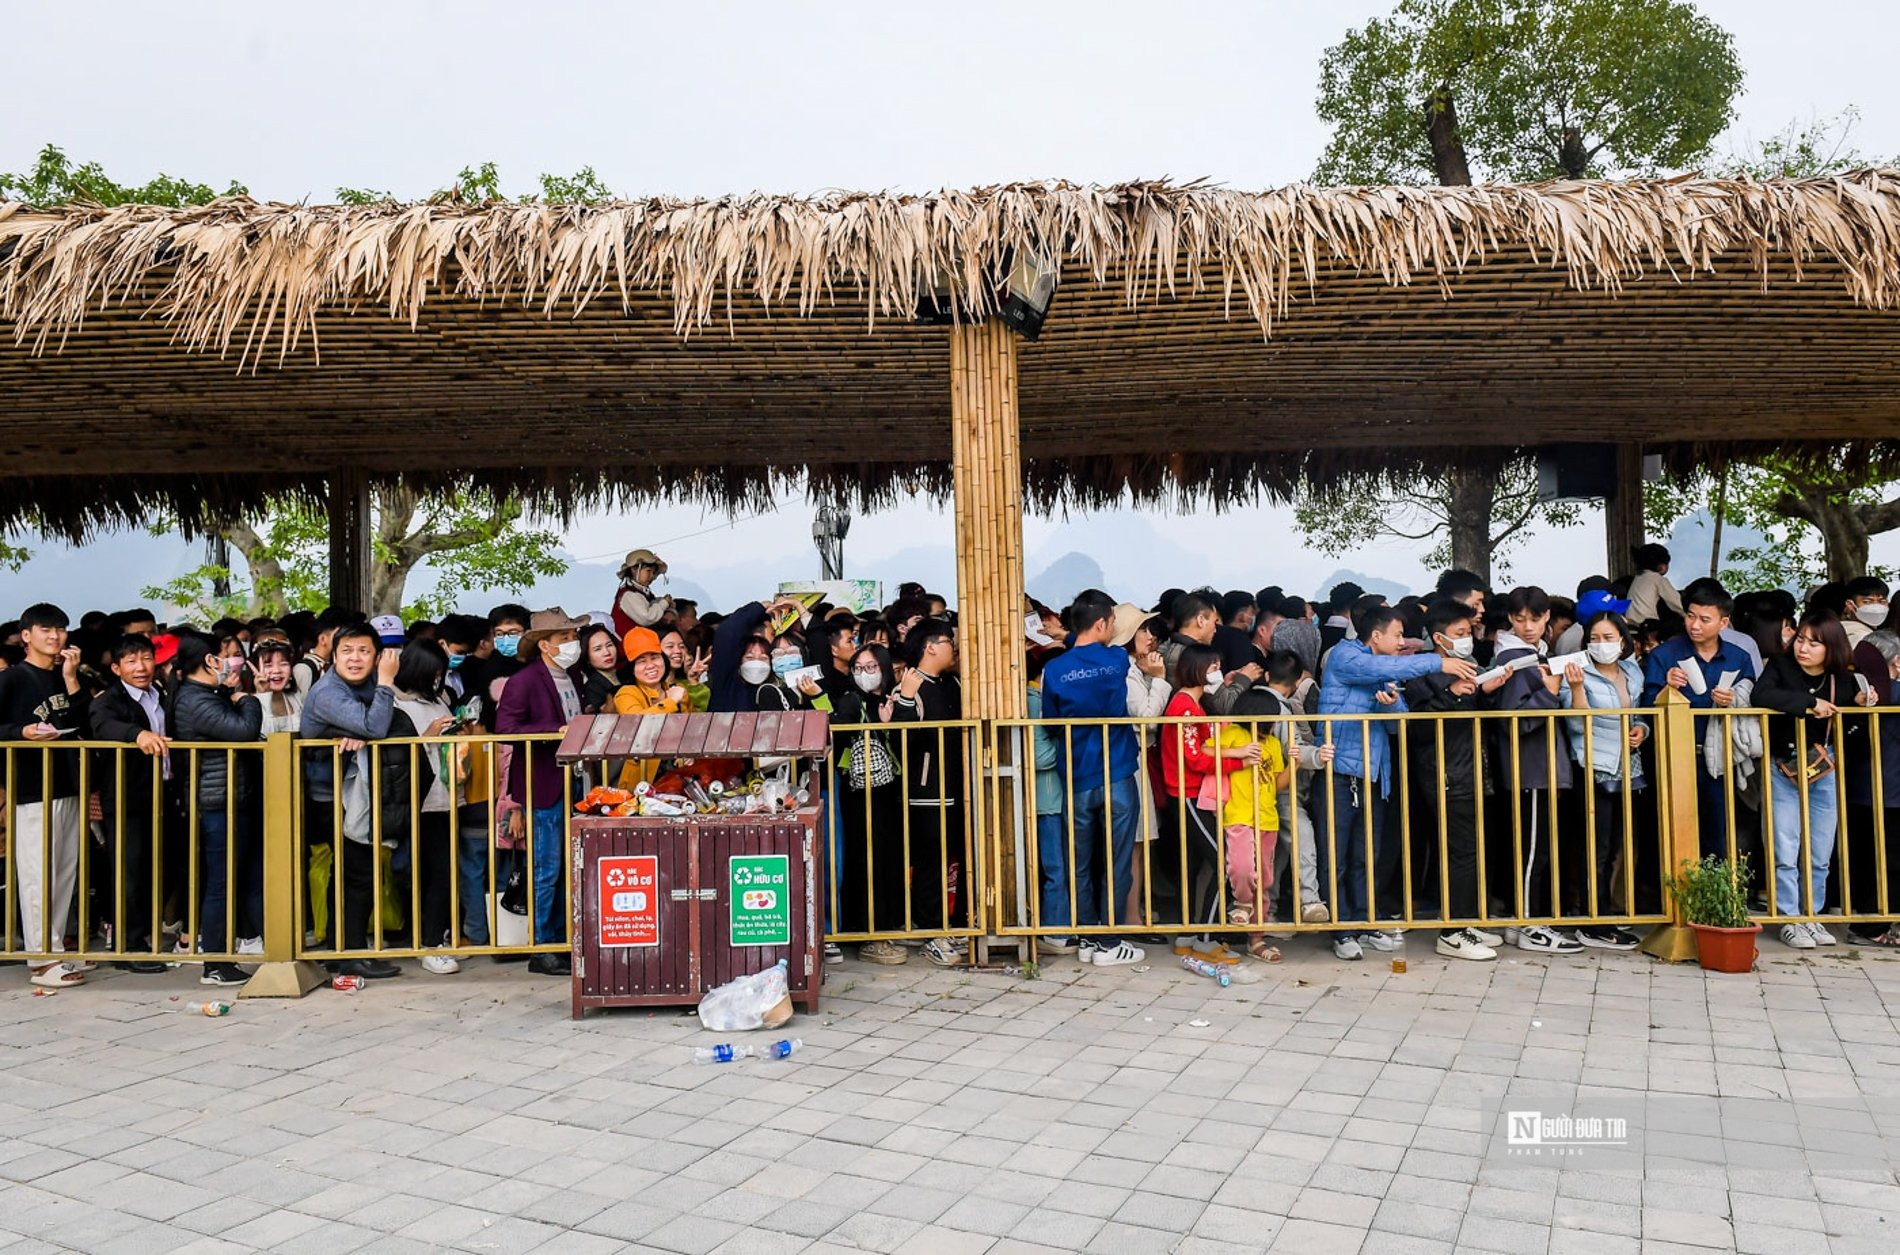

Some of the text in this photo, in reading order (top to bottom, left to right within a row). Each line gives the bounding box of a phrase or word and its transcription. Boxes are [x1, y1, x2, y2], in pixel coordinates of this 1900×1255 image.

[1060, 669, 1098, 683] adidas
[627, 874, 652, 886] VÔ CƠ
[754, 873, 784, 884] HỮU CƠ
